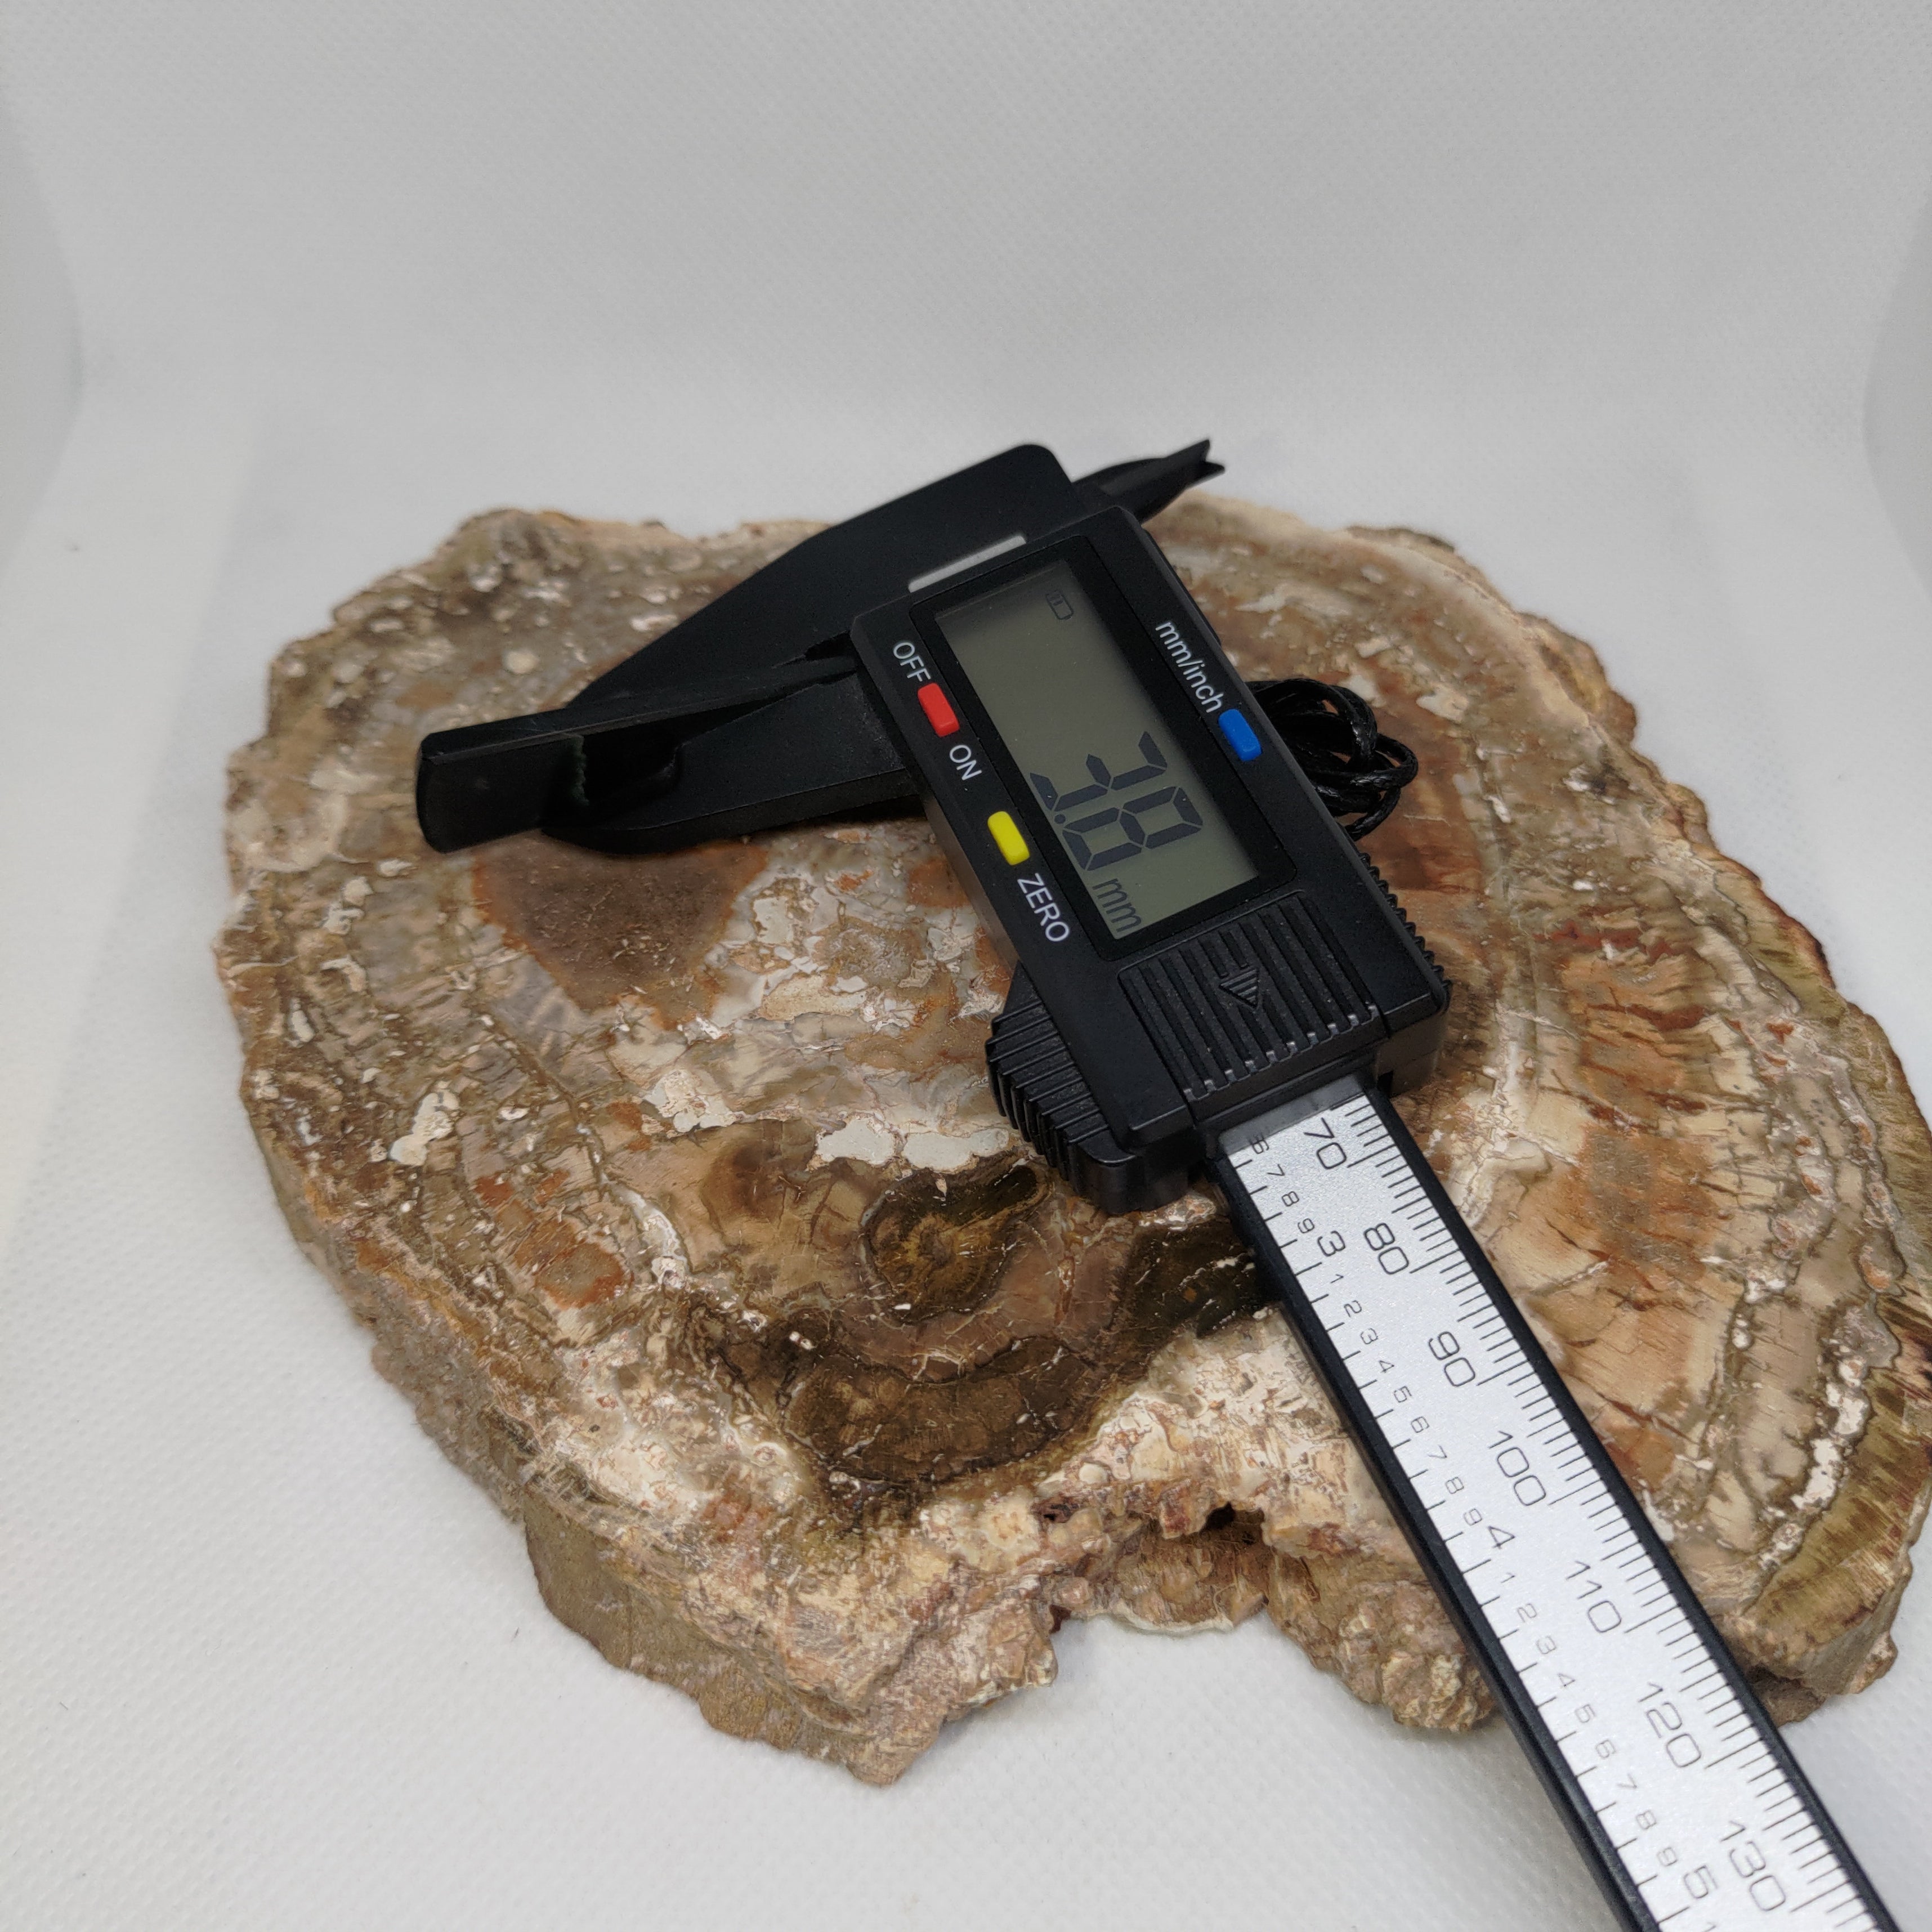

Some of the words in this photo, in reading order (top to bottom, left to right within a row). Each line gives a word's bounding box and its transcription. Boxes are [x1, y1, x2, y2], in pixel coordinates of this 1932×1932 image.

[1155, 620, 1224, 713] mm/inch
[893, 641, 931, 683] OFF
[949, 744, 982, 781] ON
[1030, 731, 1203, 871] 3.8
[1017, 873, 1071, 942] ZERO
[1093, 878, 1142, 933] mm
[1267, 1164, 1286, 1177] 7
[1281, 1191, 1299, 1207] 8
[1297, 1218, 1315, 1233] 9
[1317, 1231, 1346, 1256] 3
[1330, 1273, 1344, 1283] 1
[1344, 1300, 1362, 1317] 2
[1360, 1327, 1379, 1345] 3
[1379, 1359, 1395, 1374] 4
[1393, 1385, 1412, 1403] 5
[1410, 1416, 1430, 1433] 6
[1428, 1444, 1447, 1460] 7
[1445, 1477, 1464, 1495] 8
[1304, 1117, 1347, 1169] 70
[1363, 1222, 1409, 1275] 80
[1428, 1331, 1475, 1387] 90
[1489, 1430, 1546, 1506] 100
[1566, 1561, 1622, 1633] 110
[1638, 1682, 1702, 1768] 120
[1720, 1821, 1786, 1911] 130
[1463, 1508, 1482, 1526] 9
[1488, 1526, 1515, 1549] 4
[1501, 1572, 1515, 1583] 1
[1517, 1603, 1537, 1622] 2
[1536, 1636, 1557, 1654] 3
[1557, 1672, 1576, 1689] 4
[1575, 1704, 1595, 1723] 5
[1595, 1739, 1616, 1759] 6
[1616, 1774, 1637, 1790] 7
[1636, 1810, 1657, 1830] 8
[1657, 1846, 1678, 1867] 9
[1683, 1865, 1718, 1899] 5
